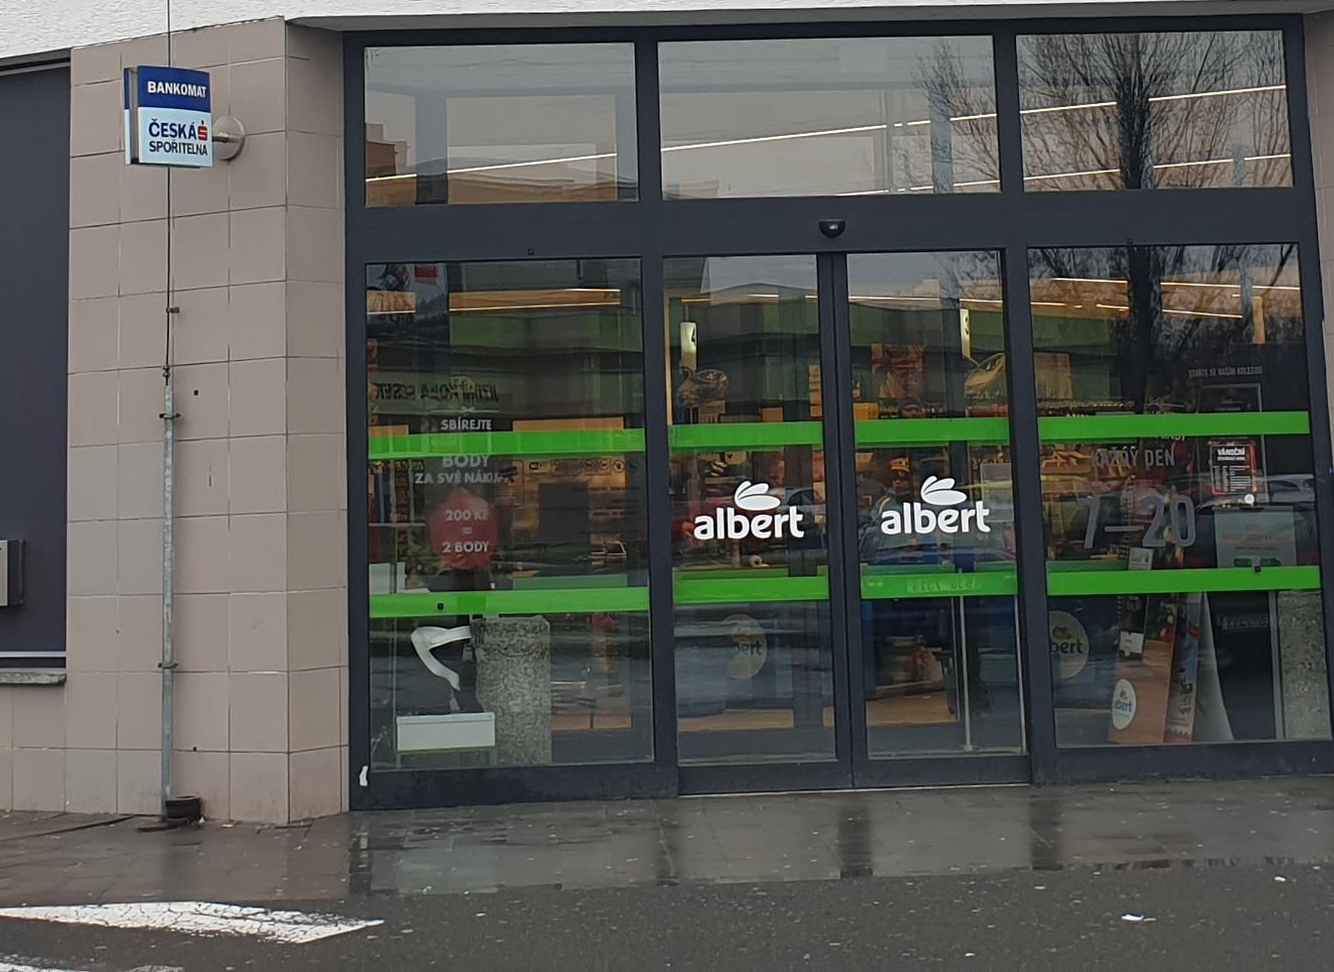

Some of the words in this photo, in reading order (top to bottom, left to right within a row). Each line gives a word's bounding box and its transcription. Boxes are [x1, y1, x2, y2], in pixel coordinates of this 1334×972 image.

[147, 81, 207, 98] BANKOMAT
[148, 118, 197, 140] ČESKÁ
[149, 139, 208, 156] SPOŘITELNA
[441, 416, 492, 430] SBÍREJTE
[415, 472, 434, 484] ZA
[437, 469, 461, 484] SVÉ
[445, 509, 470, 522] 200
[693, 505, 805, 540] albert
[881, 500, 991, 536] albert
[455, 541, 490, 554] BODY
[1051, 638, 1084, 654] bert
